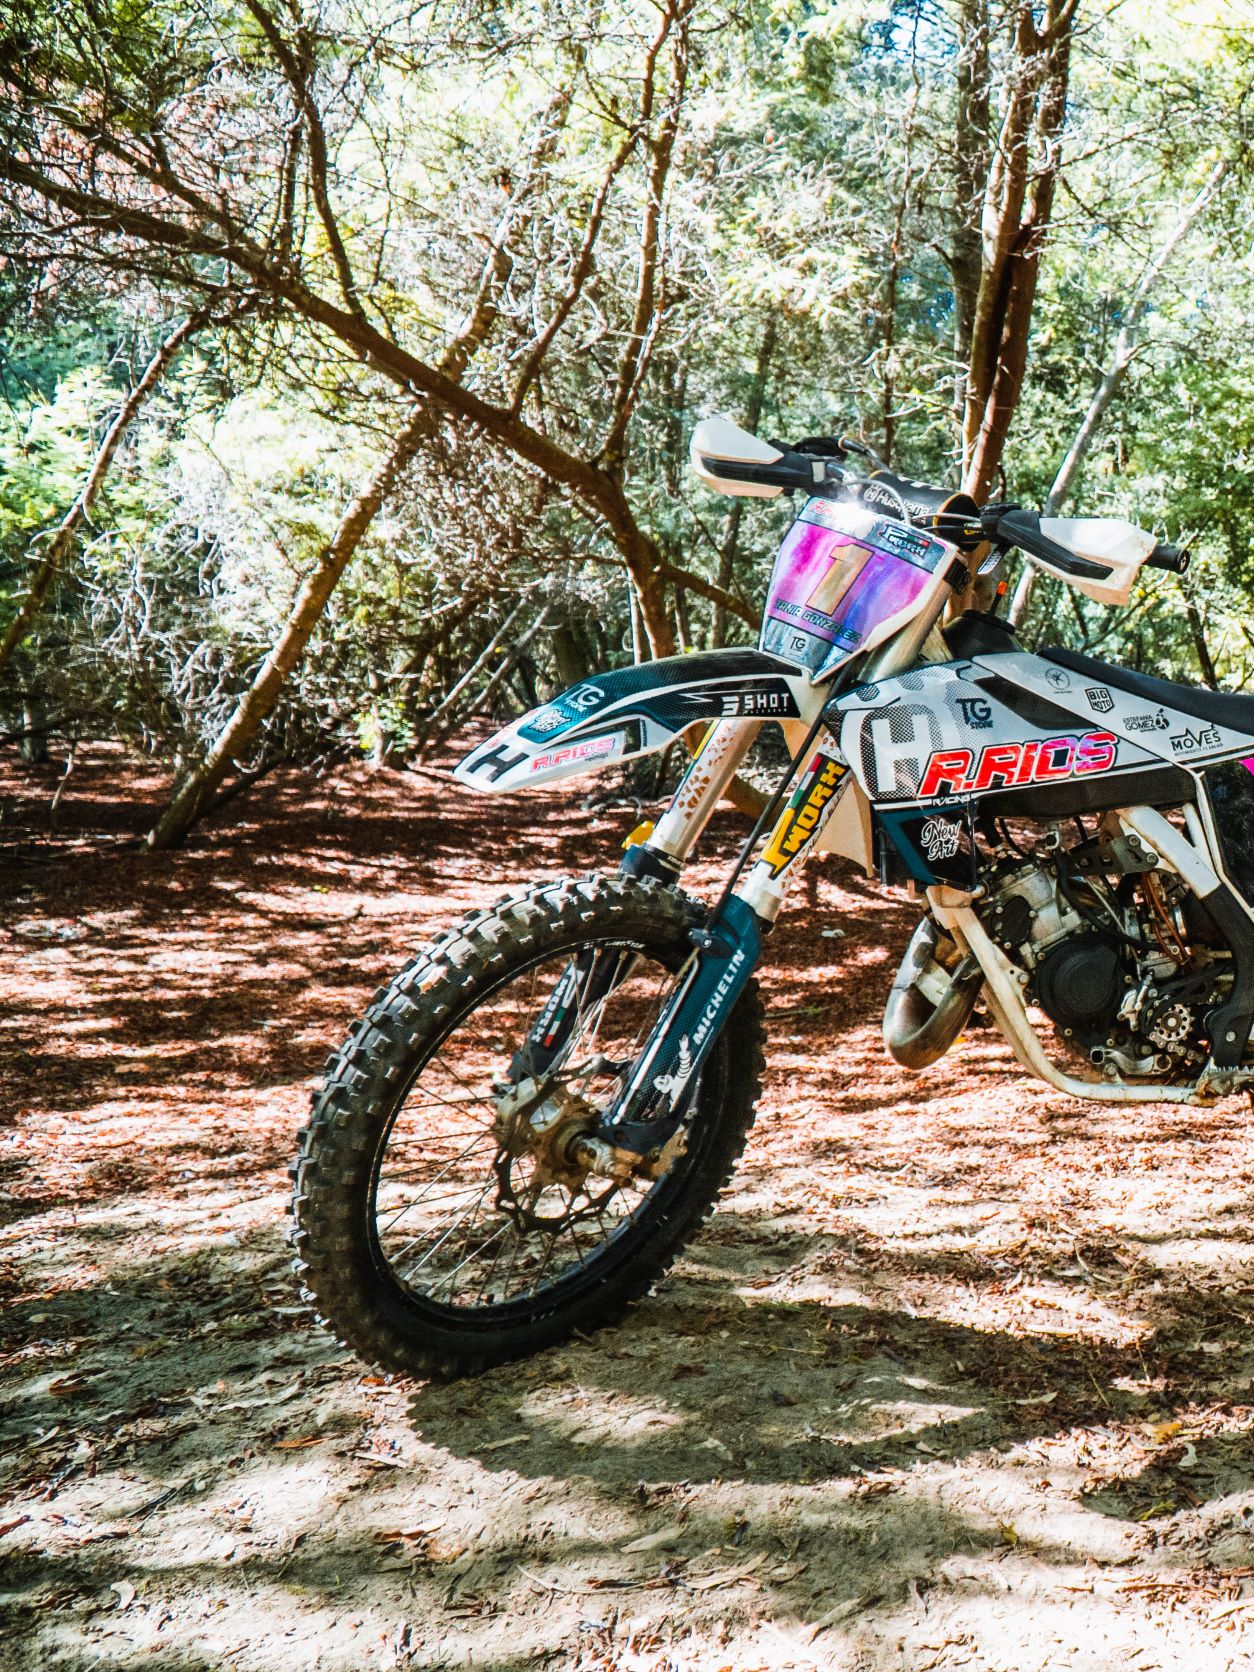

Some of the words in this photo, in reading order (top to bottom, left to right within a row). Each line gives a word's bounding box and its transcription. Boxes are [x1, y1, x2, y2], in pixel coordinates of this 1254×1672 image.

[806, 543, 875, 617] 1
[790, 636, 806, 650] TG
[566, 683, 605, 706] TG
[744, 693, 789, 709] SHOT
[1089, 690, 1108, 700] BIG
[1092, 699, 1111, 709] MOTO
[955, 697, 992, 722] TG
[969, 719, 993, 729] STORE
[1170, 730, 1222, 752] MOVES
[530, 738, 615, 773] R.RIOS
[918, 730, 1120, 798] R.RIOS
[783, 760, 846, 853] WORX
[931, 794, 972, 807] RACING
[920, 818, 963, 847] New
[927, 839, 958, 861] Art
[692, 948, 746, 1047] MICHELIN
